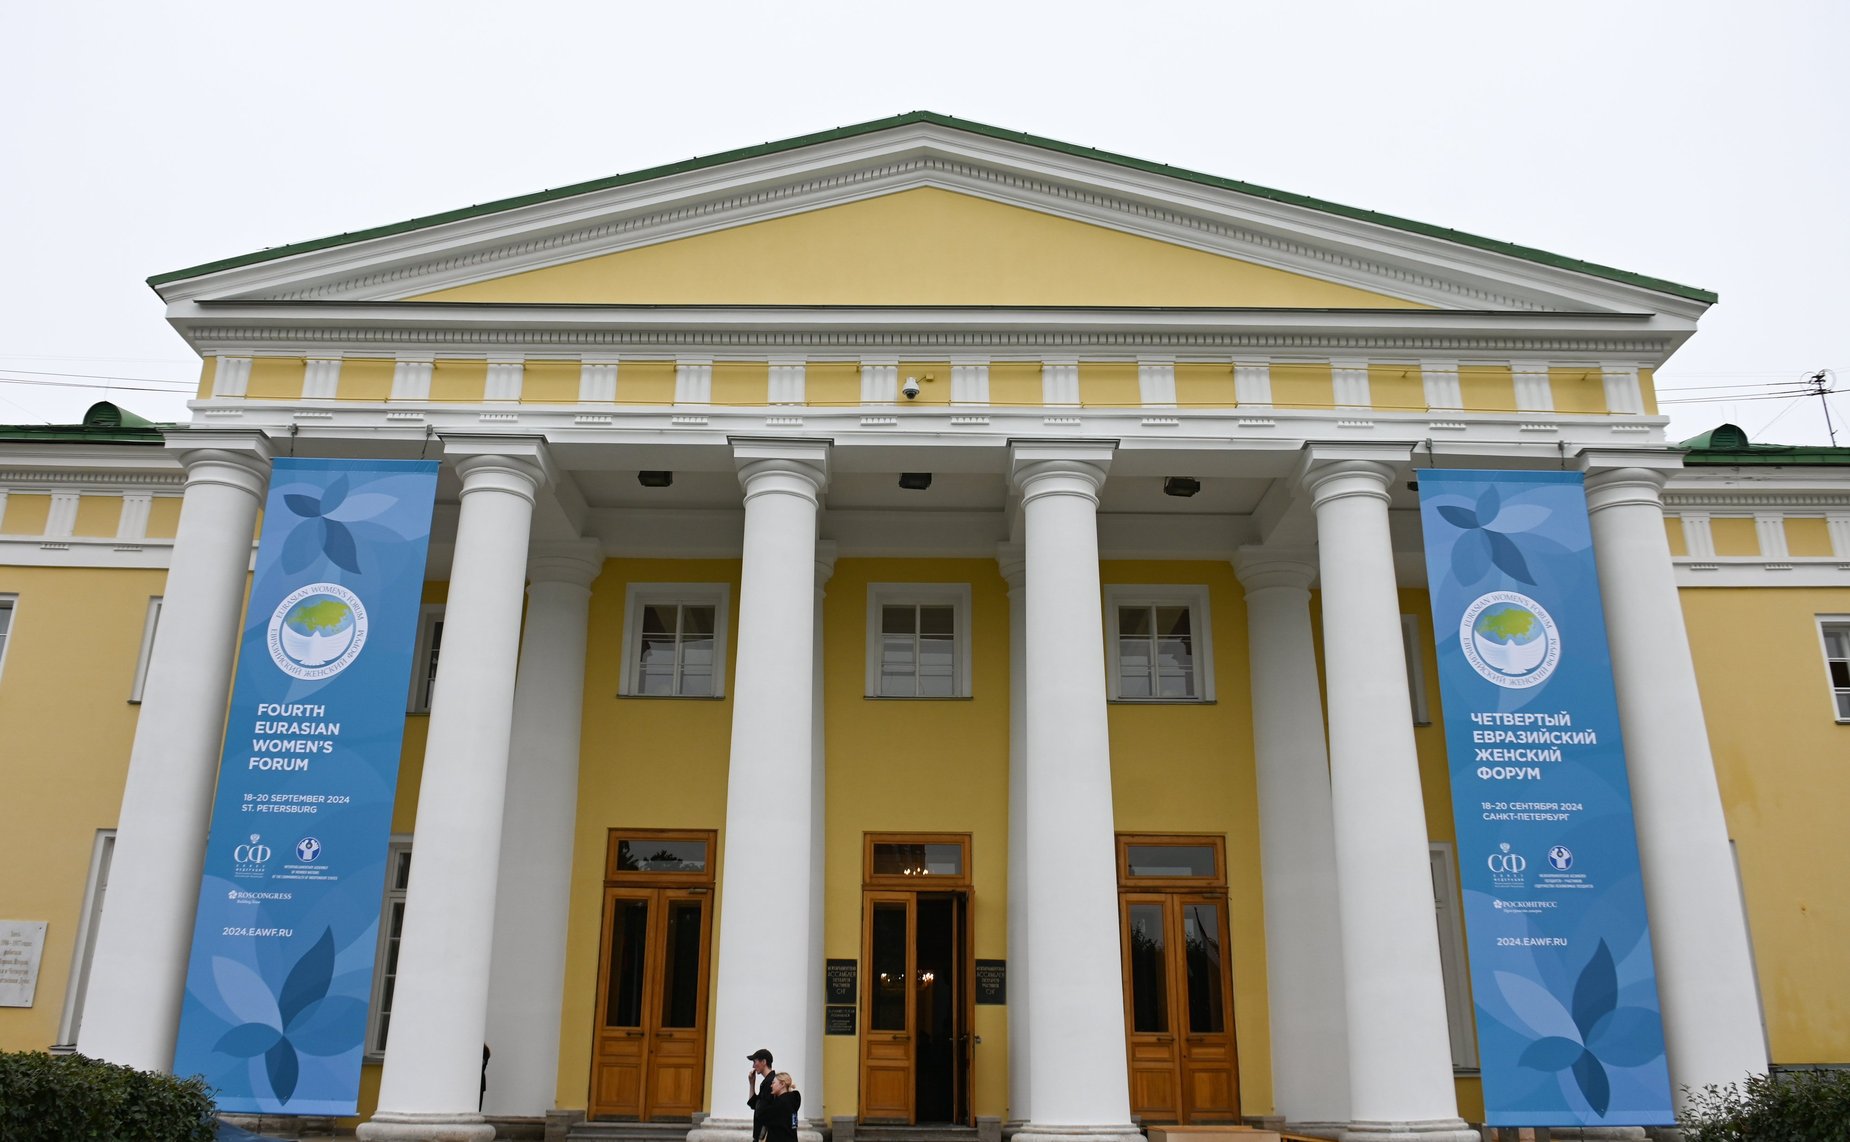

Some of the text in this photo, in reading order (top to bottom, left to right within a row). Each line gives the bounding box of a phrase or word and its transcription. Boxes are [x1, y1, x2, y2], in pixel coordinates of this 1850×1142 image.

[276, 585, 365, 621] EURASIAN WOMEN'S FORUM
[1464, 593, 1553, 629] EURASIAN WOMEN'S FORUM
[348, 629, 365, 659] ФОРУМ
[257, 703, 325, 717] FOURTH
[1471, 711, 1571, 726] ЧЕТВЕРТЫЙ
[254, 721, 340, 736] EURASIAN
[1473, 729, 1597, 745] ЕВРАЗИЙСКИЙ
[252, 739, 333, 753] WOMEN’S
[1475, 746, 1562, 762] ЖЕНСКИЙ
[248, 757, 309, 771] FORUM
[1477, 766, 1541, 780] ФОРУМ
[271, 794, 325, 803] SEPTEMBER
[326, 795, 350, 804] 2024
[241, 804, 317, 814] ST. PETERSBURG
[1509, 802, 1559, 811] СЕНТЯБРЯ
[1560, 803, 1583, 811] 2024
[1482, 812, 1570, 821] САНКТ-ПЕТЕРБУРГ
[234, 844, 271, 864] СФ
[1488, 853, 1526, 873] СФ
[237, 890, 292, 900] ROSCONGRESS
[1502, 900, 1557, 909] РОСКОНГРЕСС
[222, 927, 293, 937] 2024.EAWF.RU
[1497, 937, 1568, 946] 2024.EAWF.RU
